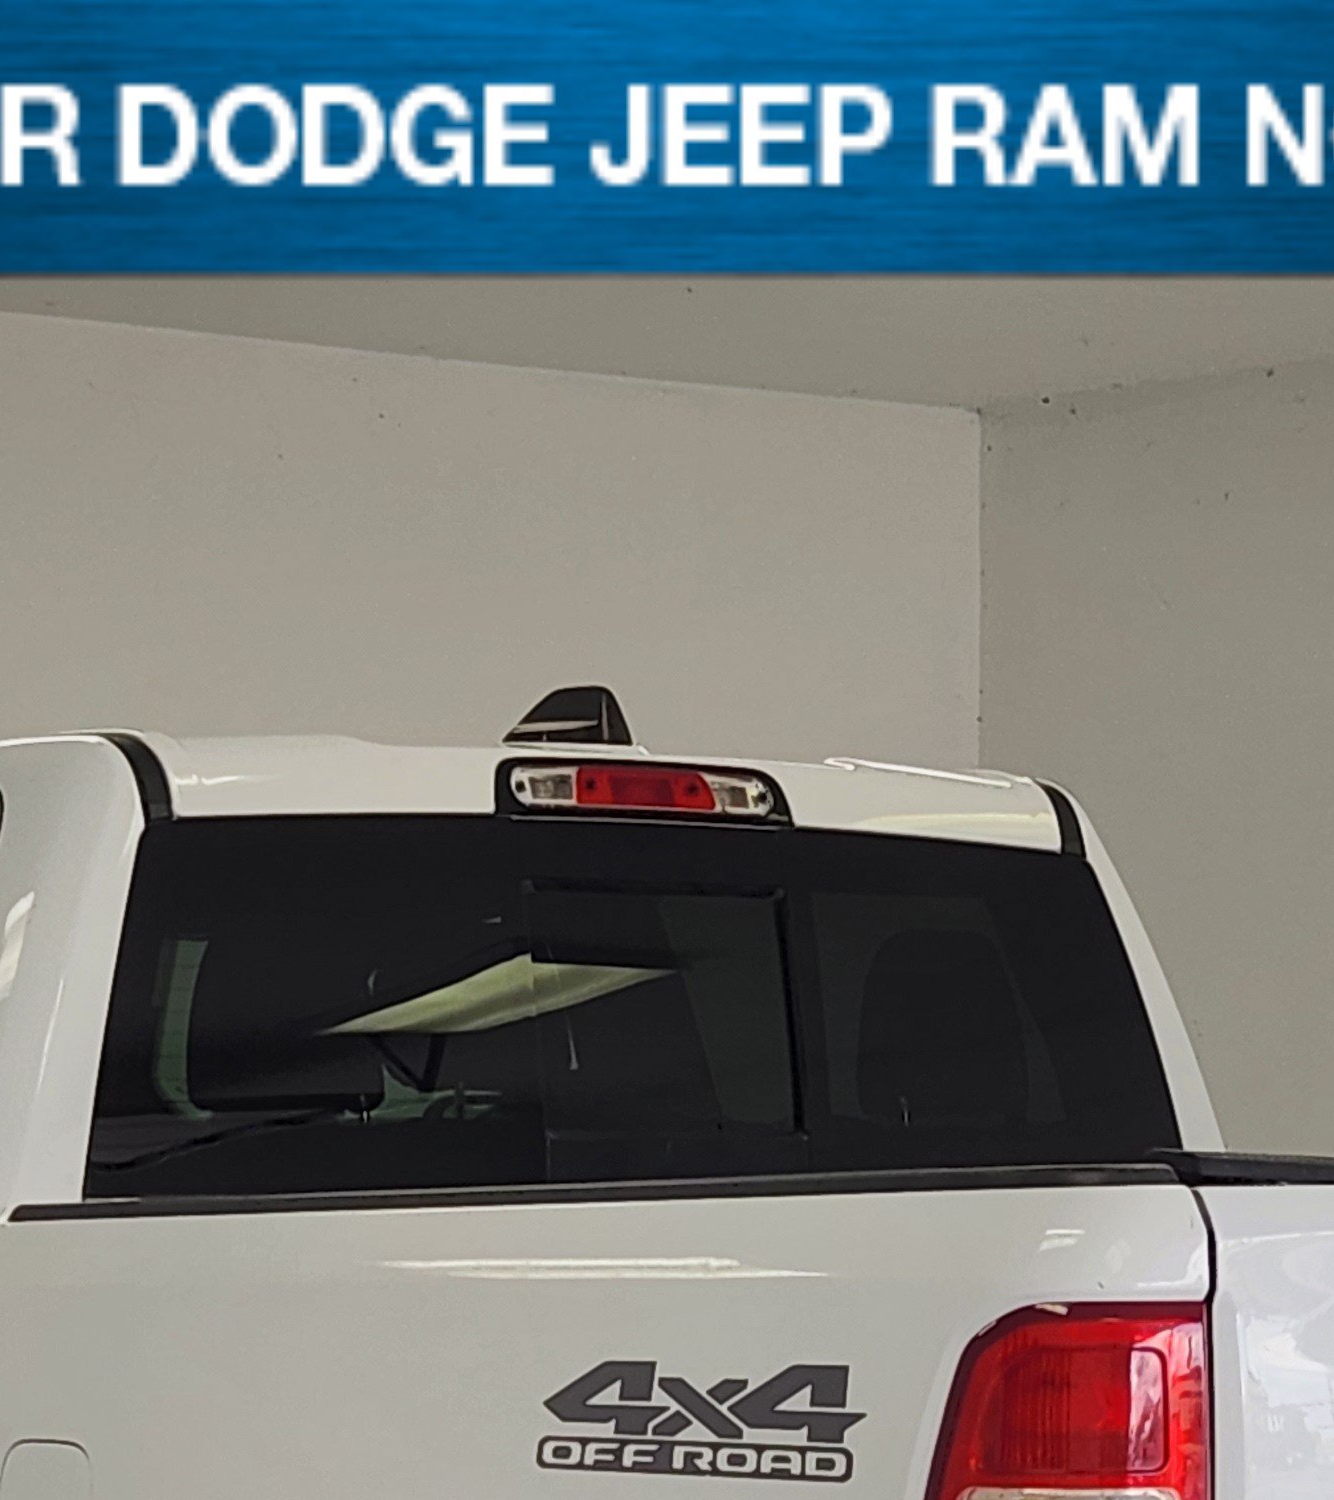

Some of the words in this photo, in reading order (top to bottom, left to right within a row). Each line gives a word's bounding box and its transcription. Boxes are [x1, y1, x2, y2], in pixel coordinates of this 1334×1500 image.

[543, 1360, 867, 1443] 4x4
[541, 1439, 661, 1468] OFF
[671, 1444, 848, 1478] ROAD
